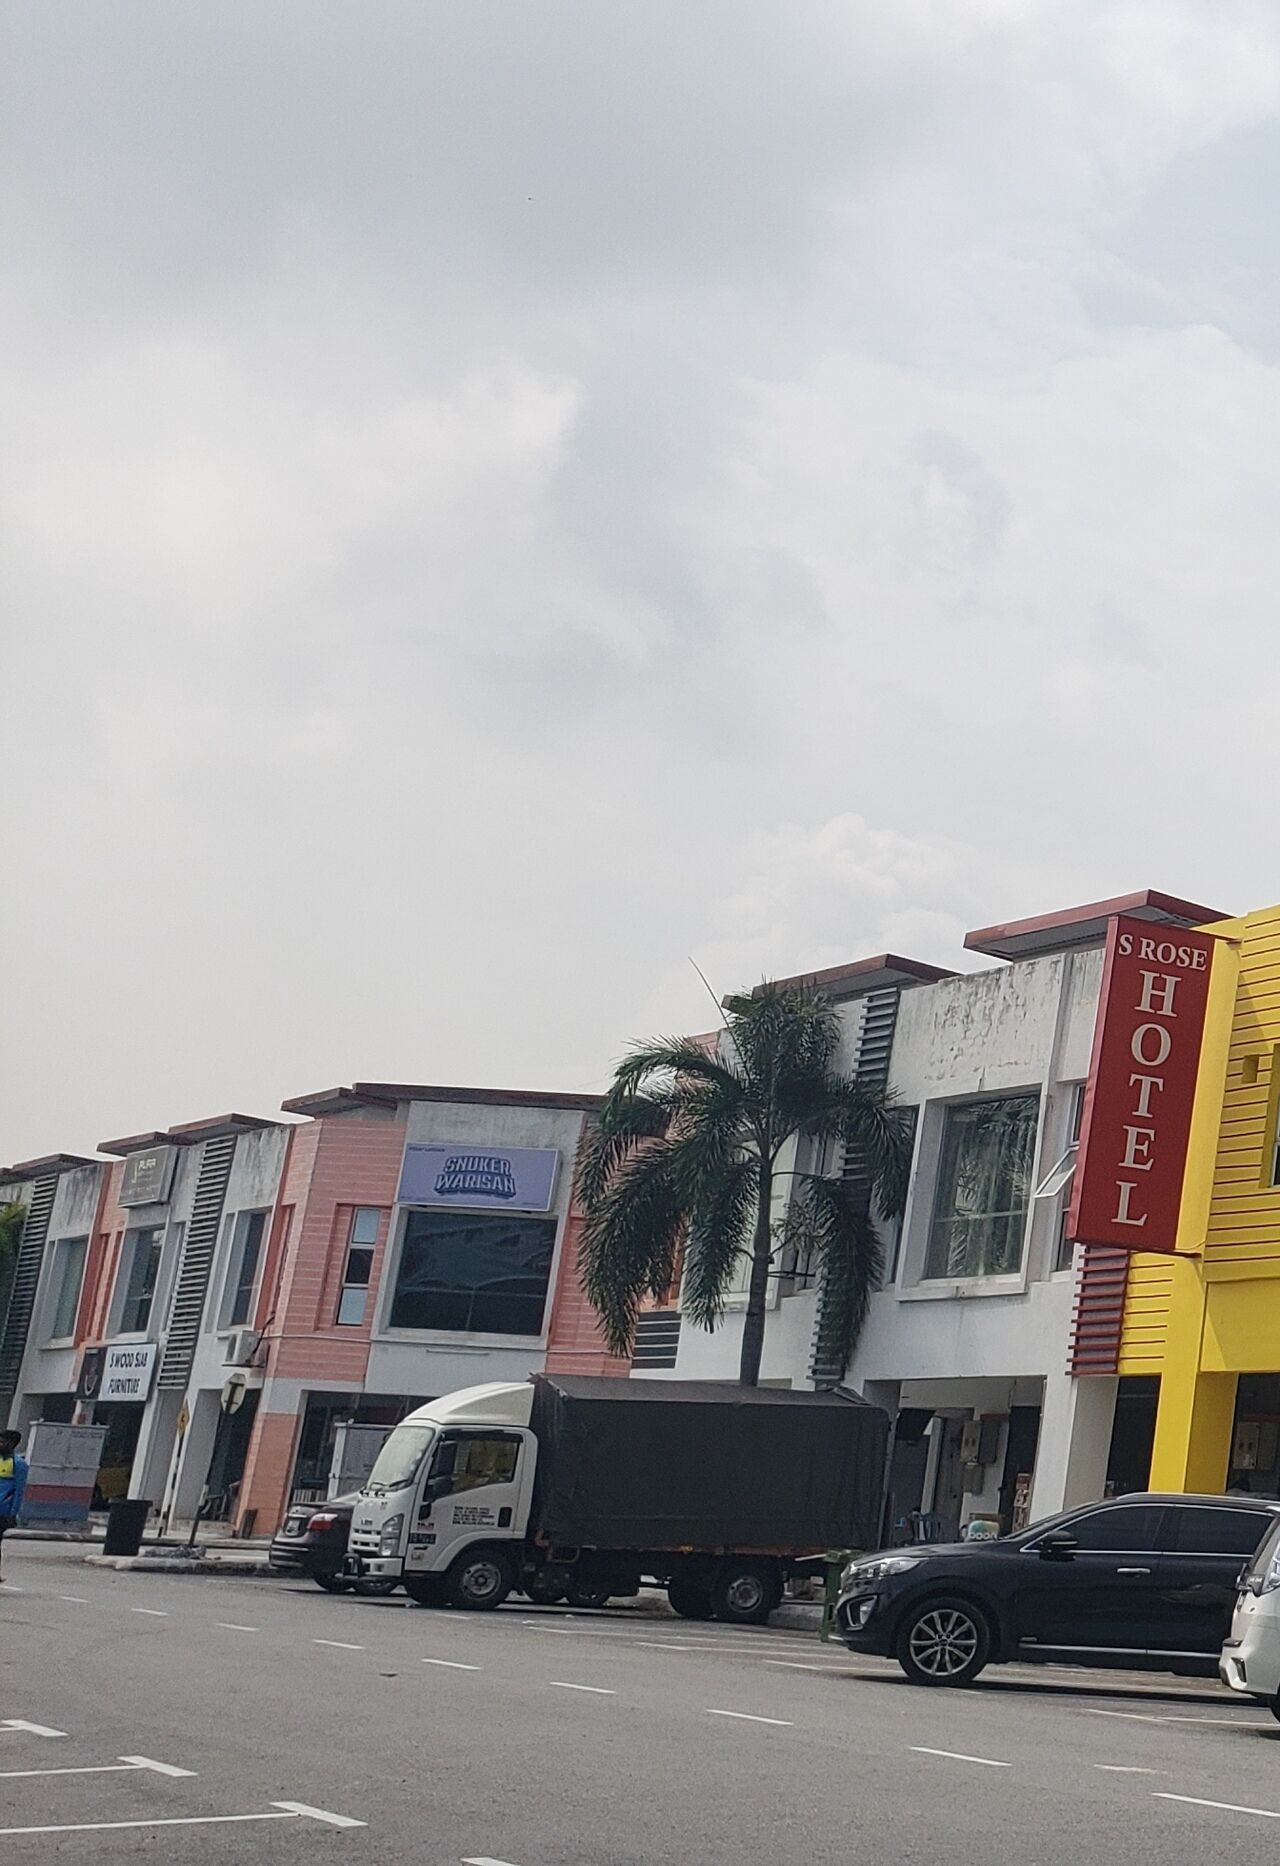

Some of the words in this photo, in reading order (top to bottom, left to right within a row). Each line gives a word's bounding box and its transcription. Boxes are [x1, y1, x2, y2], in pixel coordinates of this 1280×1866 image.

[1118, 933, 1134, 956] S
[1137, 938, 1208, 971] ROSE
[1110, 969, 1182, 1227] HOTEL
[444, 1156, 511, 1176] SNUKER
[435, 1174, 516, 1195] WARISAN
